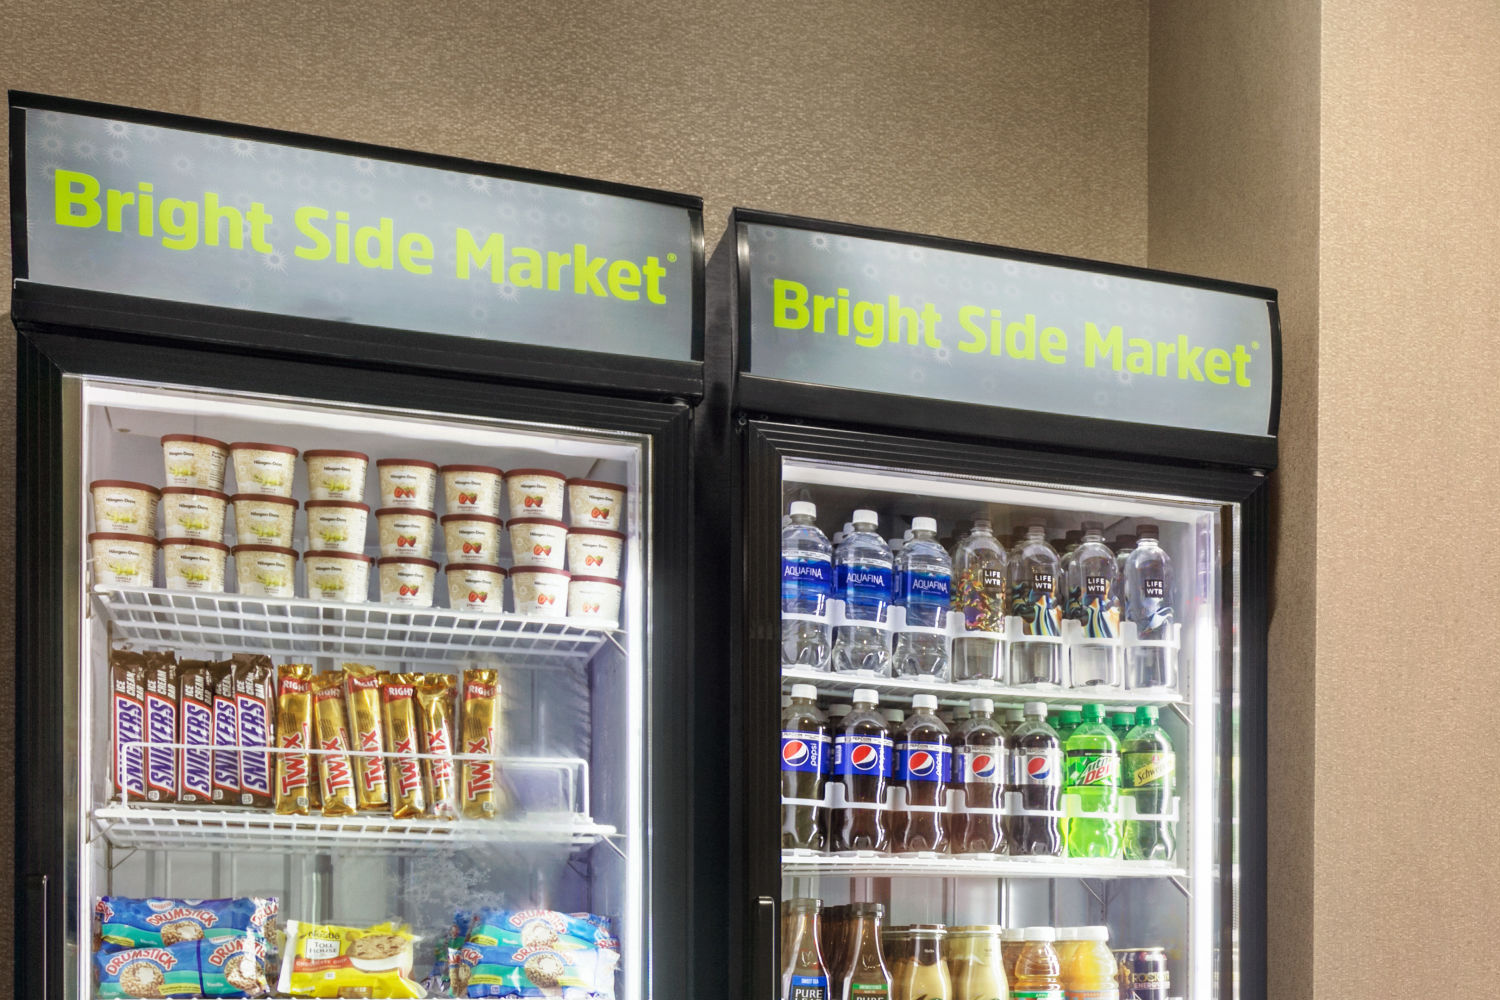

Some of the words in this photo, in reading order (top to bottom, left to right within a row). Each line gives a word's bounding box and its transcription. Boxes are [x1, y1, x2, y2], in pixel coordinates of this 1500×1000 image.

[54, 168, 274, 252] Bright
[294, 205, 434, 275] Side
[773, 278, 942, 349] Bright
[958, 305, 1068, 365] Side
[784, 565, 824, 580] AQUAFINA
[984, 570, 1001, 578] LIFE
[846, 572, 885, 588] AQUAFINA
[984, 577, 1002, 586] WTR
[1035, 575, 1052, 583] LIFE
[1087, 577, 1105, 585] LIFE
[912, 578, 948, 593] AQUAFINA
[1035, 583, 1052, 591] WTR
[1088, 585, 1106, 593] WTR
[1146, 581, 1163, 589] LIFE
[1146, 588, 1163, 596] WTR
[810, 742, 819, 767] pepsi
[146, 908, 219, 928] DRUMSTICK
[105, 948, 177, 975] DRUMSTICK
[795, 988, 823, 998] PURE
